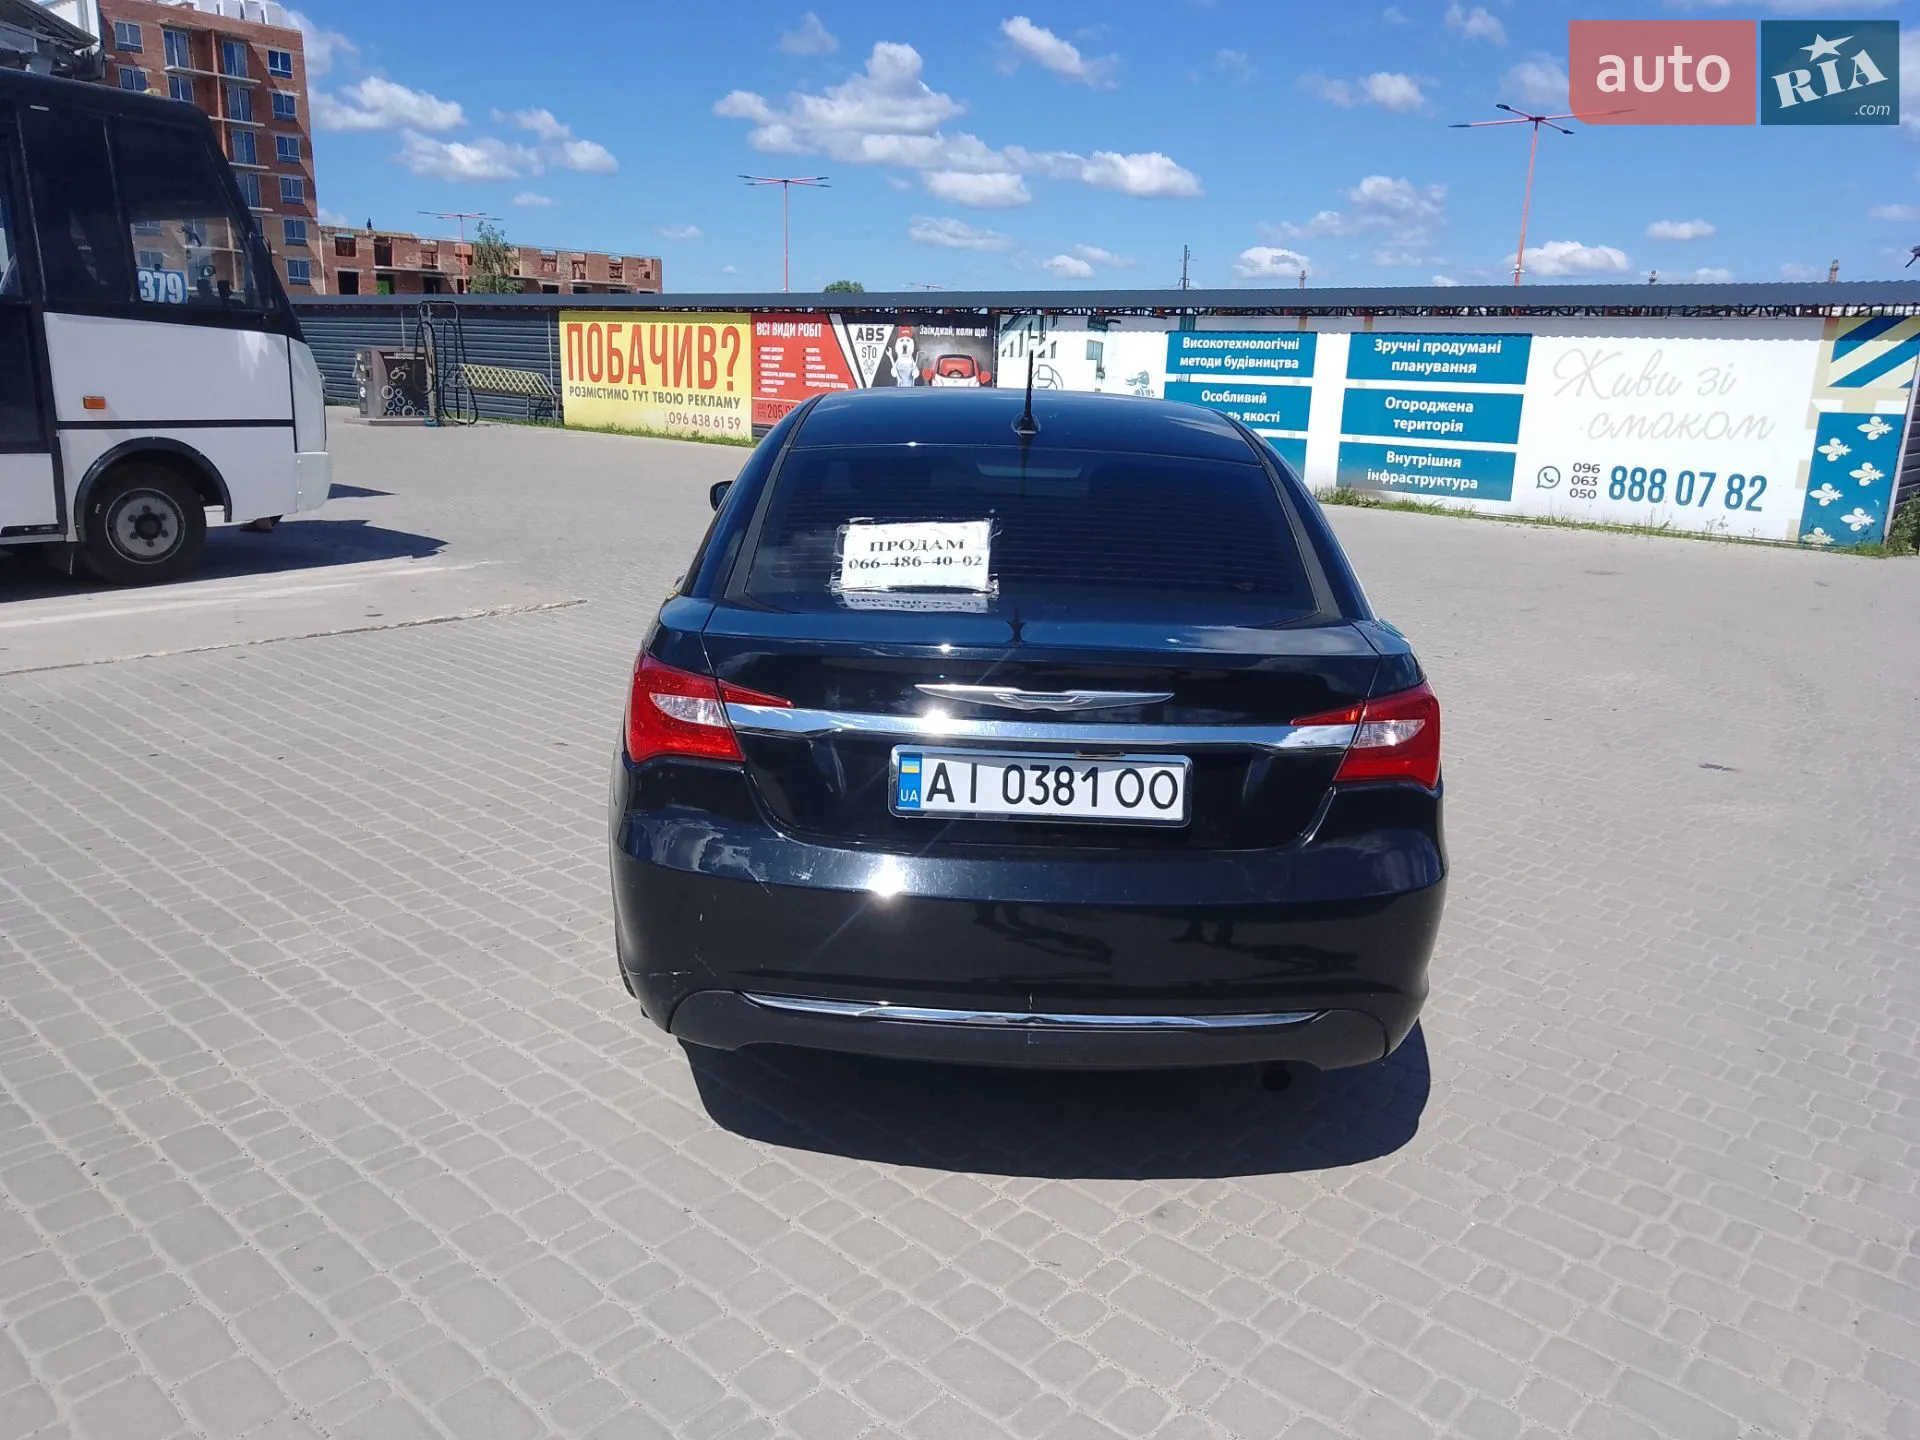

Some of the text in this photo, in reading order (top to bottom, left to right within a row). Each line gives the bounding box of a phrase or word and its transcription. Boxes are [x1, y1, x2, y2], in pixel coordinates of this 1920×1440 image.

[138, 270, 183, 304] 379
[756, 322, 822, 338] ВСІ ВИДИ РОБІТ
[856, 327, 885, 341] ABS
[1182, 336, 1300, 350] Високотехнологічні
[1374, 338, 1502, 355] Зручні продумані
[566, 322, 741, 392] ПОБАЧИВ?
[1180, 355, 1299, 370] методи будівництва
[1391, 361, 1477, 375] планування
[1552, 348, 1738, 400] Живи зі
[569, 386, 741, 409] РОЗМІСТИМО ТУТ ТВОЮ РЕКЛАМУ
[1201, 390, 1267, 404] Особливий
[1385, 397, 1474, 413] Огороджена
[669, 411, 689, 425] 096
[692, 413, 710, 427] 438
[1243, 411, 1280, 423] якості
[1588, 409, 1776, 441] смаком
[1393, 418, 1464, 435] територія
[1386, 450, 1462, 468] Внутрішня
[1572, 462, 1601, 474] 096
[1367, 468, 1479, 490] інфраструктура
[1571, 475, 1599, 487] 063
[1569, 487, 1597, 500] 050
[1608, 465, 1768, 513] 888 07 82
[869, 538, 965, 553] ПРОДАМ
[849, 555, 983, 570] 066-486-40-02
[926, 762, 1178, 810] AI 0381 OO
[900, 789, 919, 802] UA
